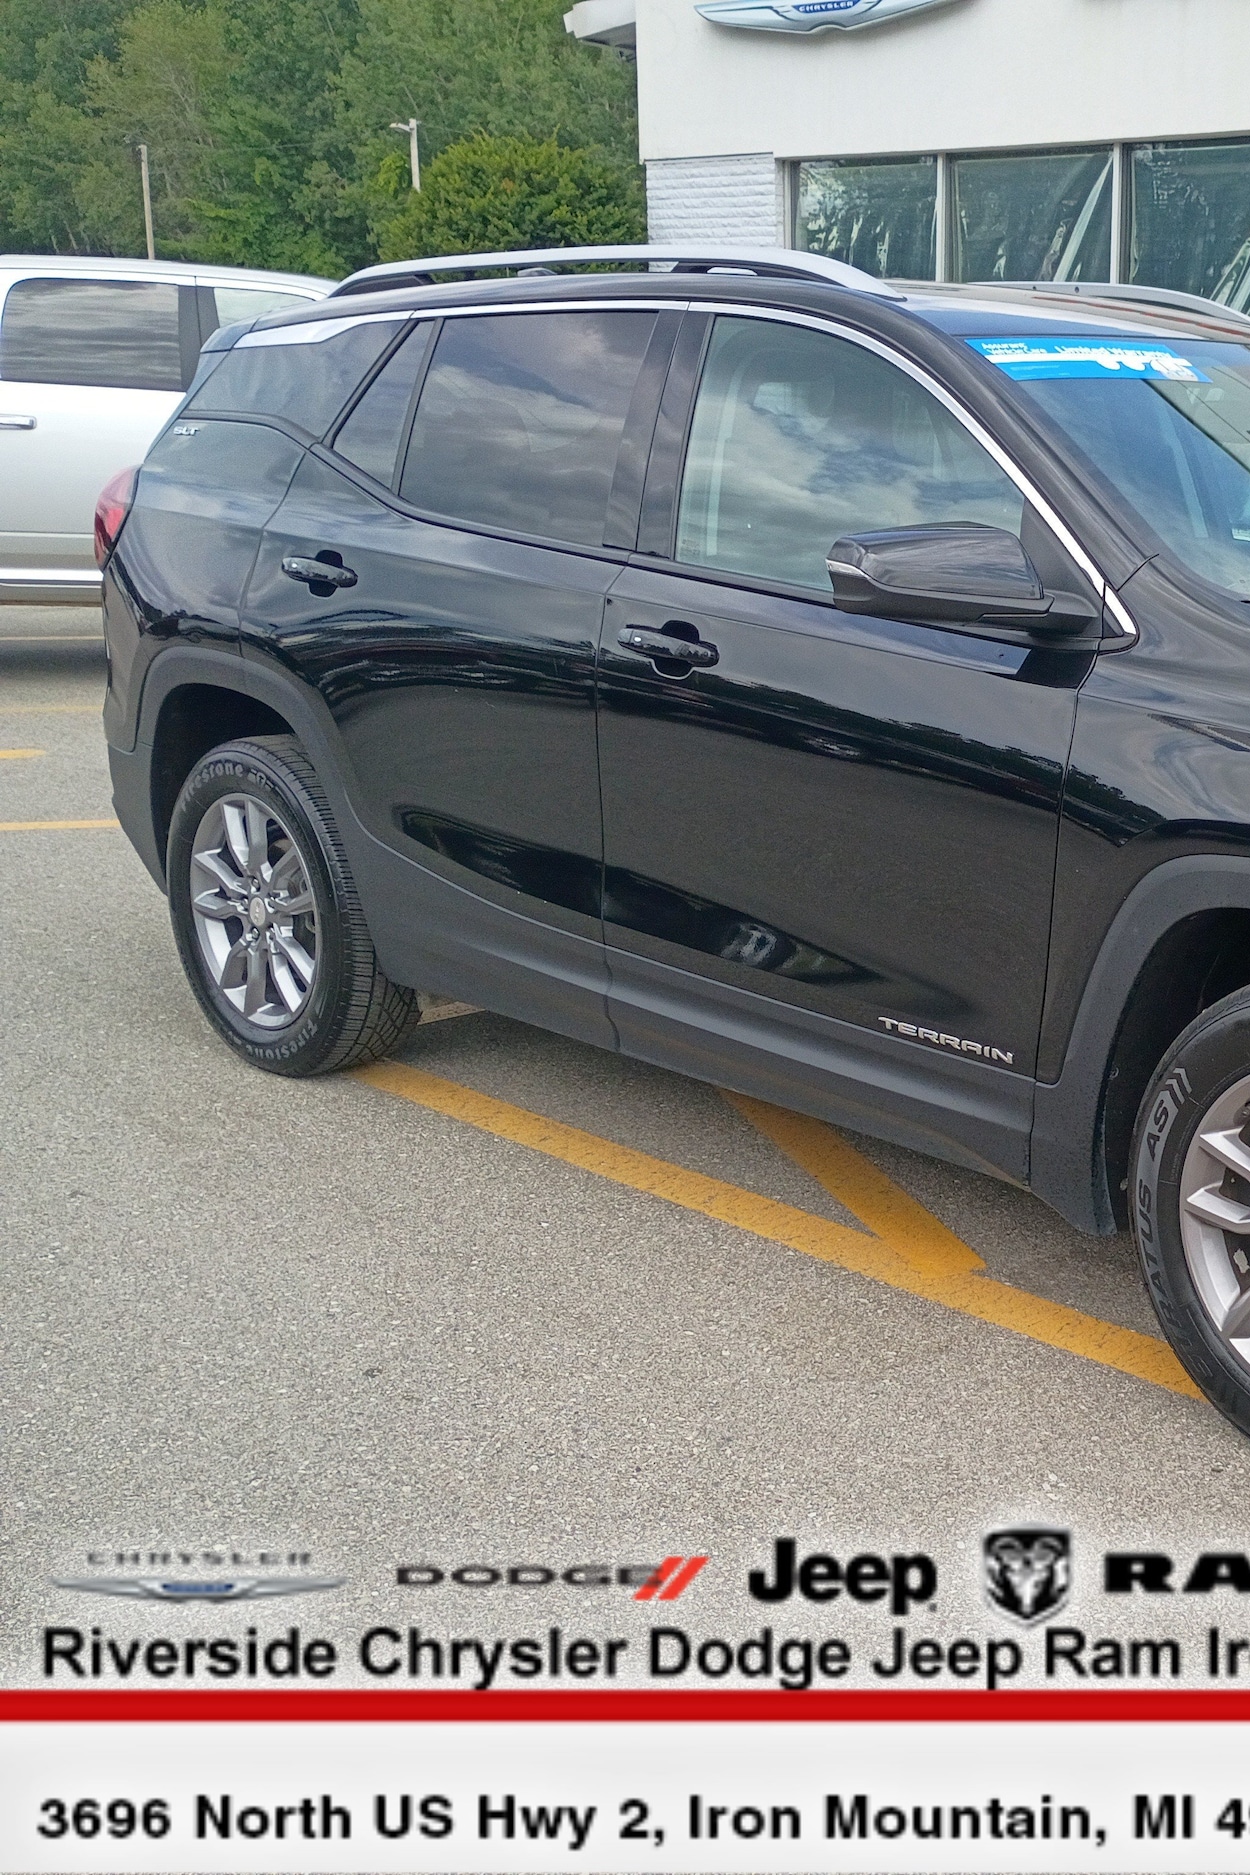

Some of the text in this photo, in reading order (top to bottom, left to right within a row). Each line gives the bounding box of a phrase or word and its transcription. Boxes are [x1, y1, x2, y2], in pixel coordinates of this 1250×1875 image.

[798, 1, 854, 12] CHRYSLER
[877, 1016, 1014, 1065] TERRAIN
[1146, 1100, 1169, 1162] AS
